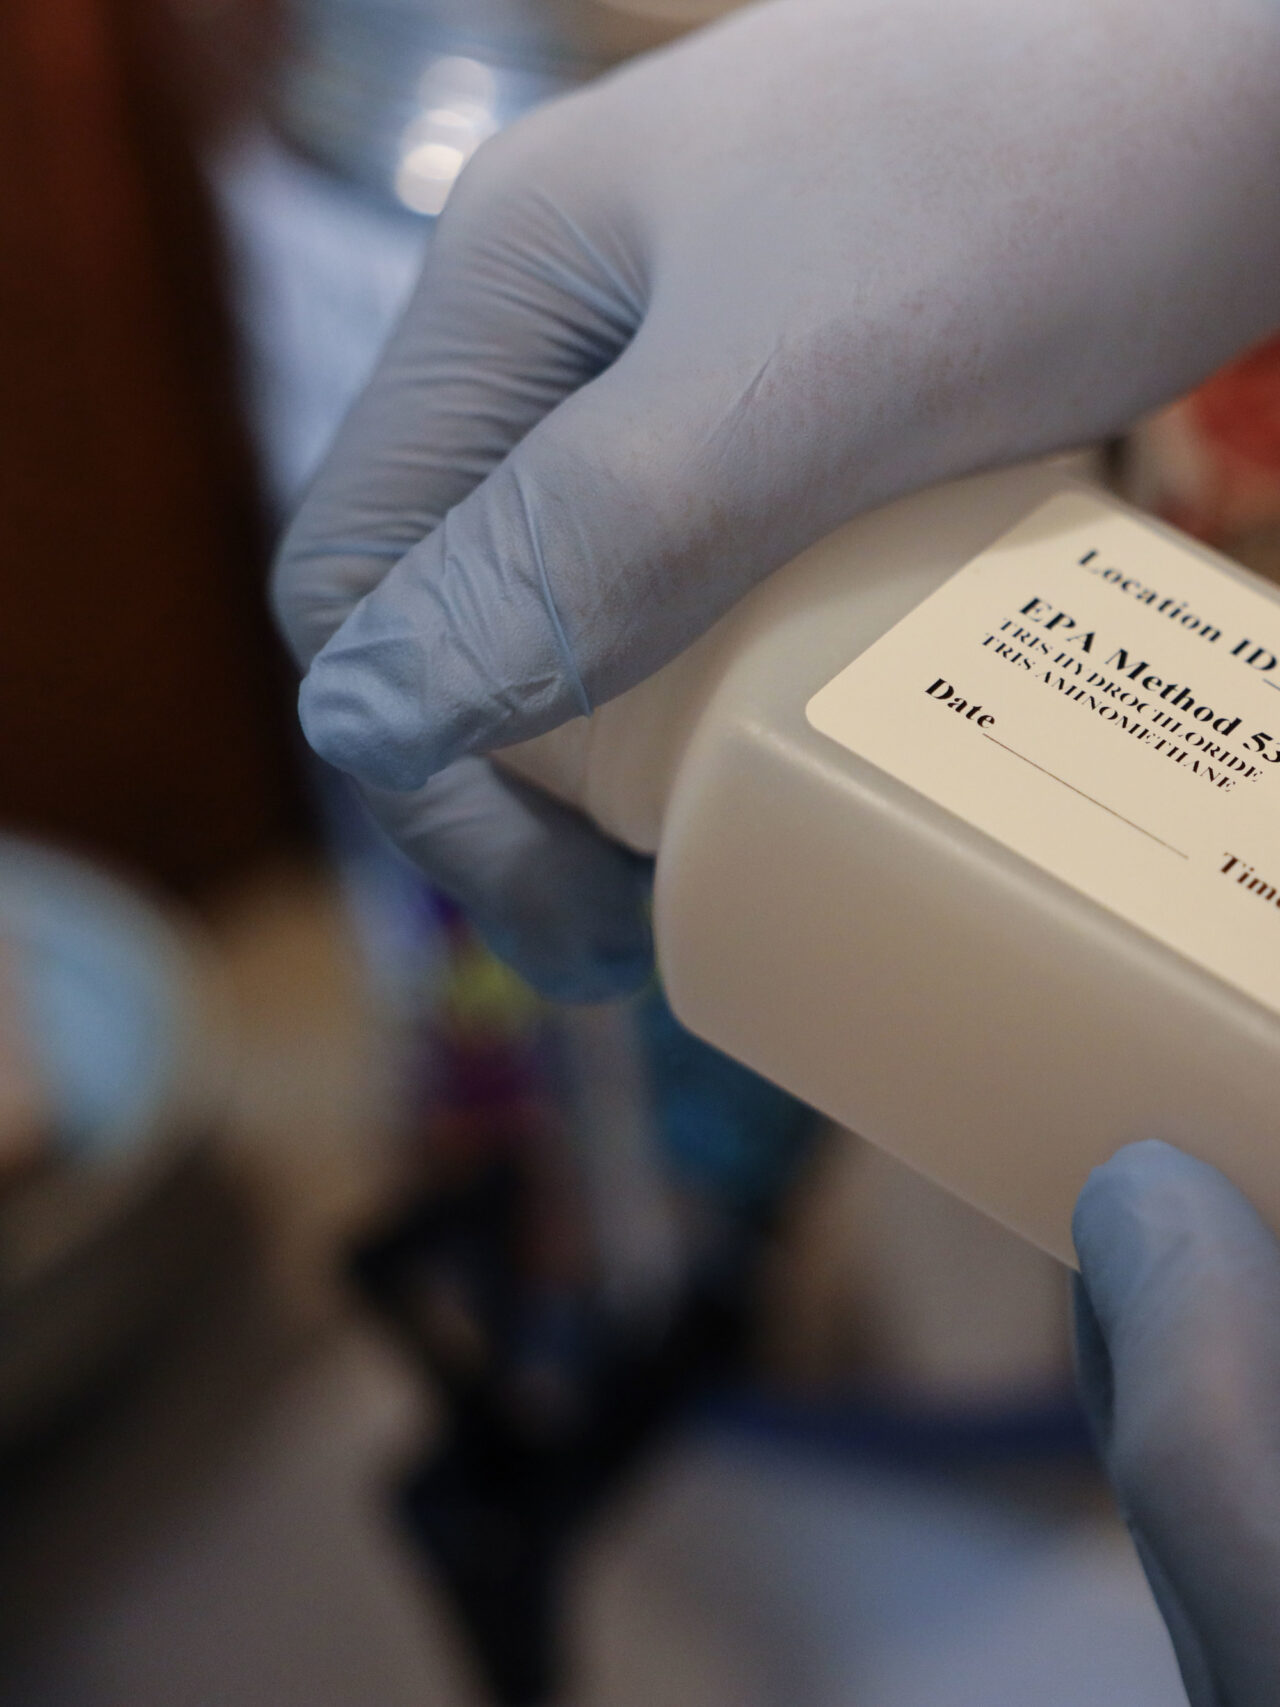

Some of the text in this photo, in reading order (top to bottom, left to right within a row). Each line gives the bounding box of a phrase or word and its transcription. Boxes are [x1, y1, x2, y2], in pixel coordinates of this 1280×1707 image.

[1019, 597, 1096, 653] EPA
[1104, 648, 1242, 736] Method
[1078, 549, 1278, 673] Location ID
[924, 677, 996, 729] Date
[982, 632, 1036, 671] TRIS
[1035, 670, 1236, 792] AMINOMETHANE
[1000, 617, 1052, 655] TRIS
[1053, 652, 1263, 782] HYDROCHLORIDE
